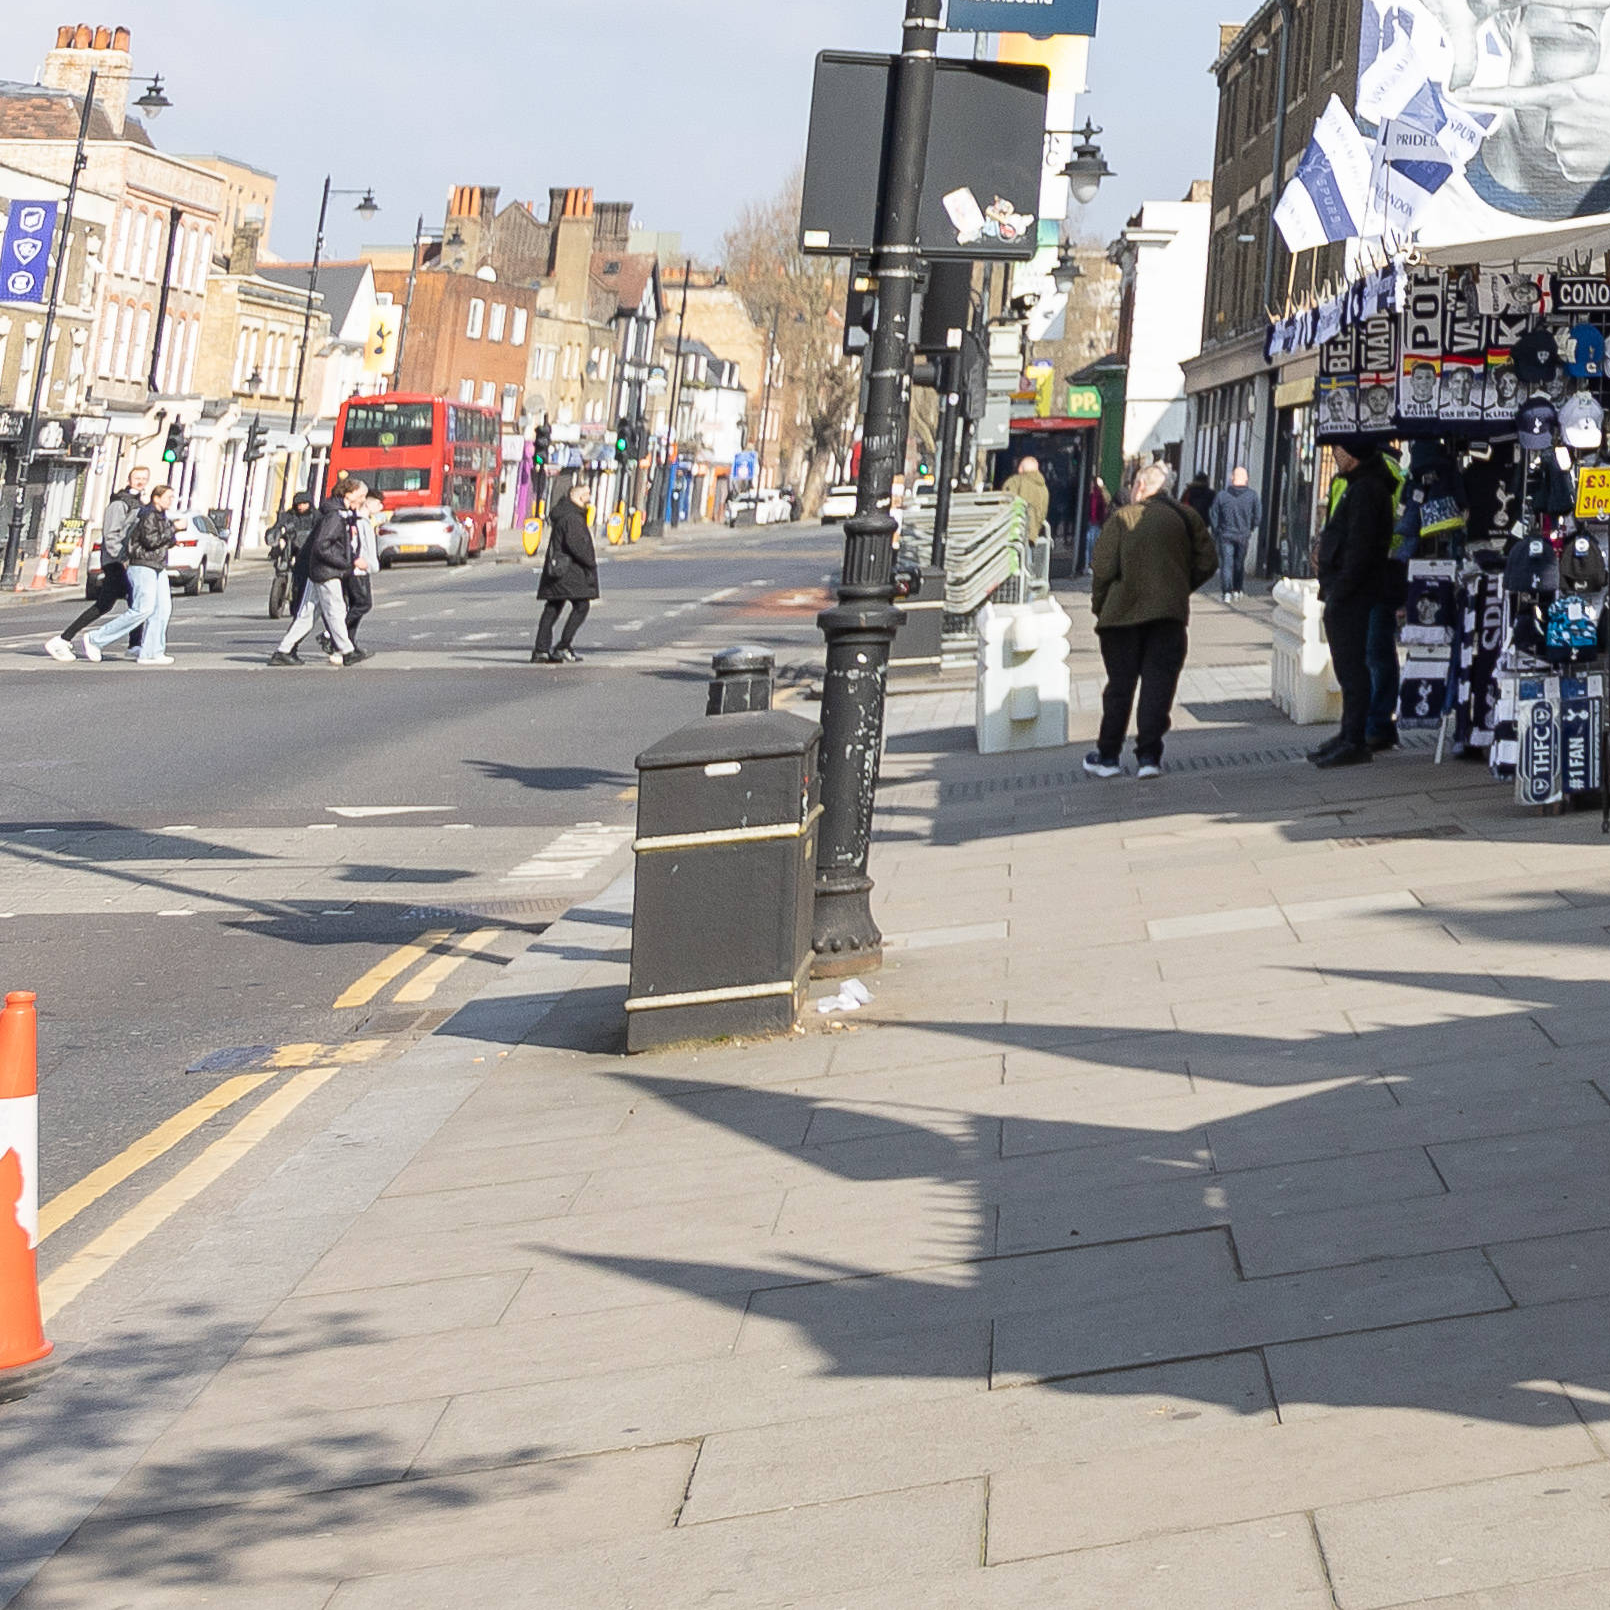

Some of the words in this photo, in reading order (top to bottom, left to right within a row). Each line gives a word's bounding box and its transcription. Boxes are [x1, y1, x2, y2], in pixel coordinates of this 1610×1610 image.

[1532, 723, 1551, 774] THFC
[1566, 735, 1585, 765] FAN
[1567, 767, 1586, 790] #1
